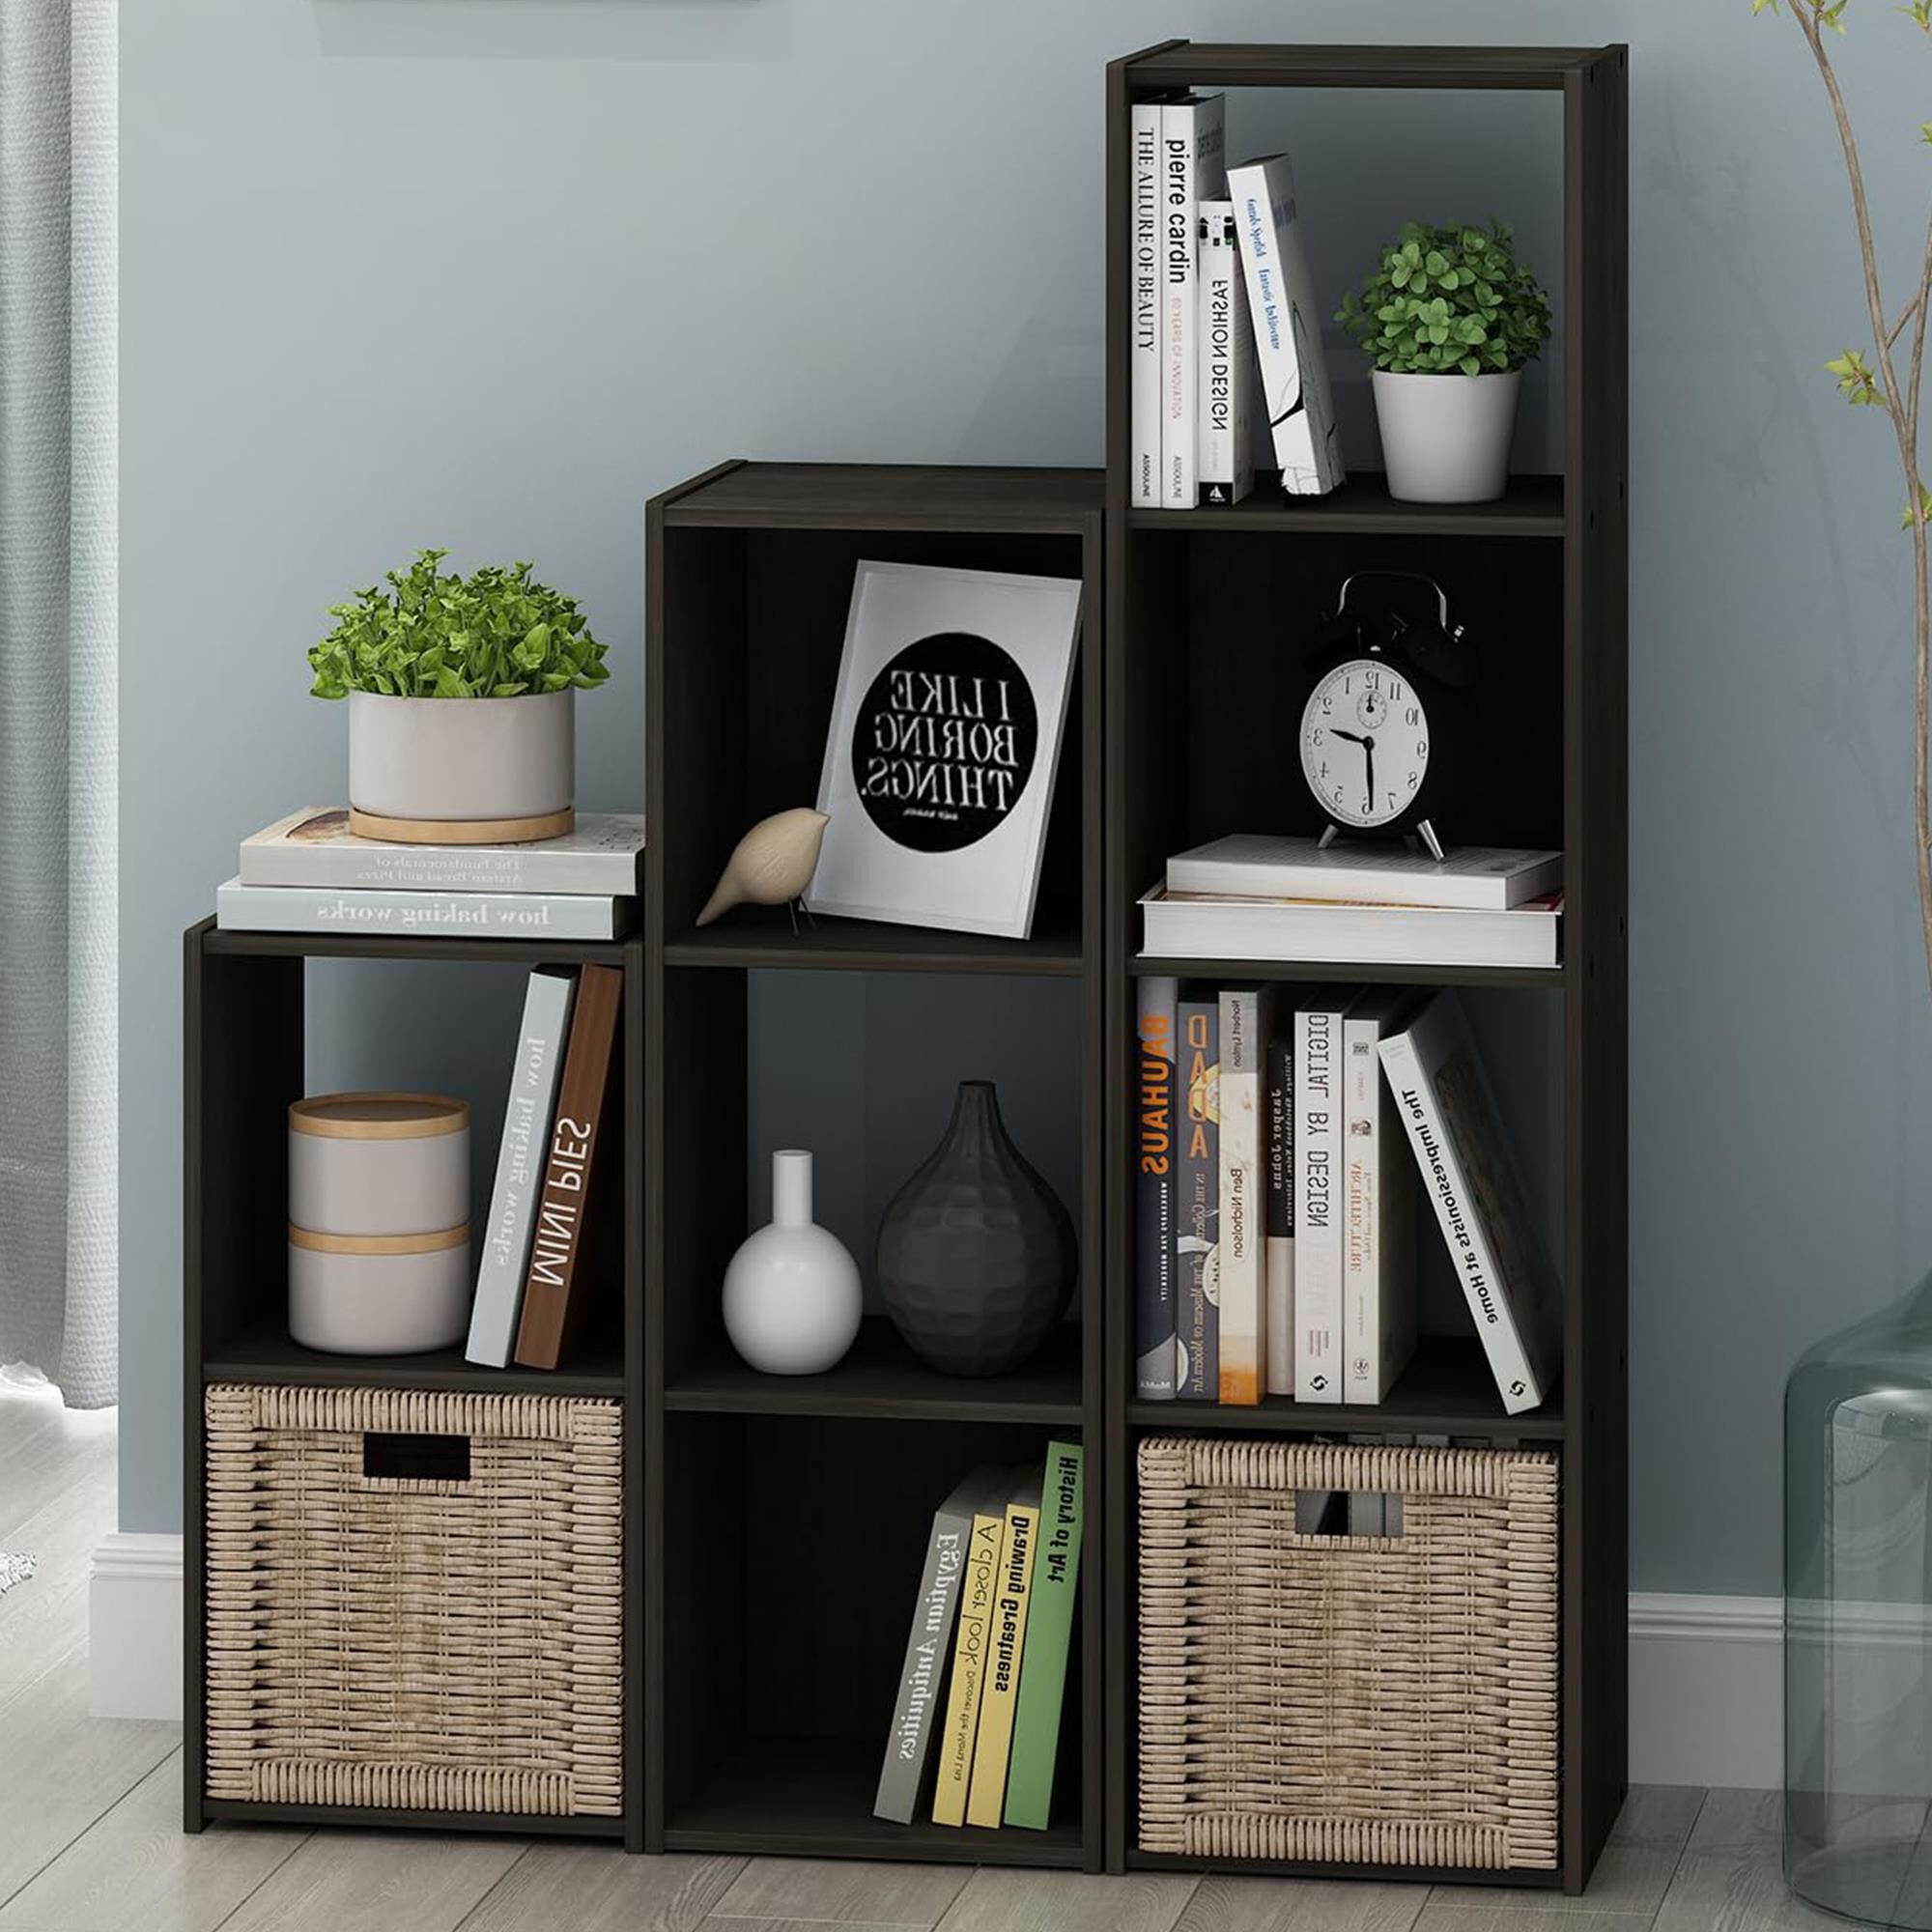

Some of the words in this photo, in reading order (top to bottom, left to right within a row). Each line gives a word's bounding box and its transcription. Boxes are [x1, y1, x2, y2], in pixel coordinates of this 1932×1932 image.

[1137, 128, 1154, 165] THE
[1165, 139, 1189, 205] pierre
[1137, 170, 1154, 243] ALLURE
[1137, 246, 1154, 272] OF
[1169, 213, 1190, 283] cardin
[1137, 276, 1154, 353] BEAUTY
